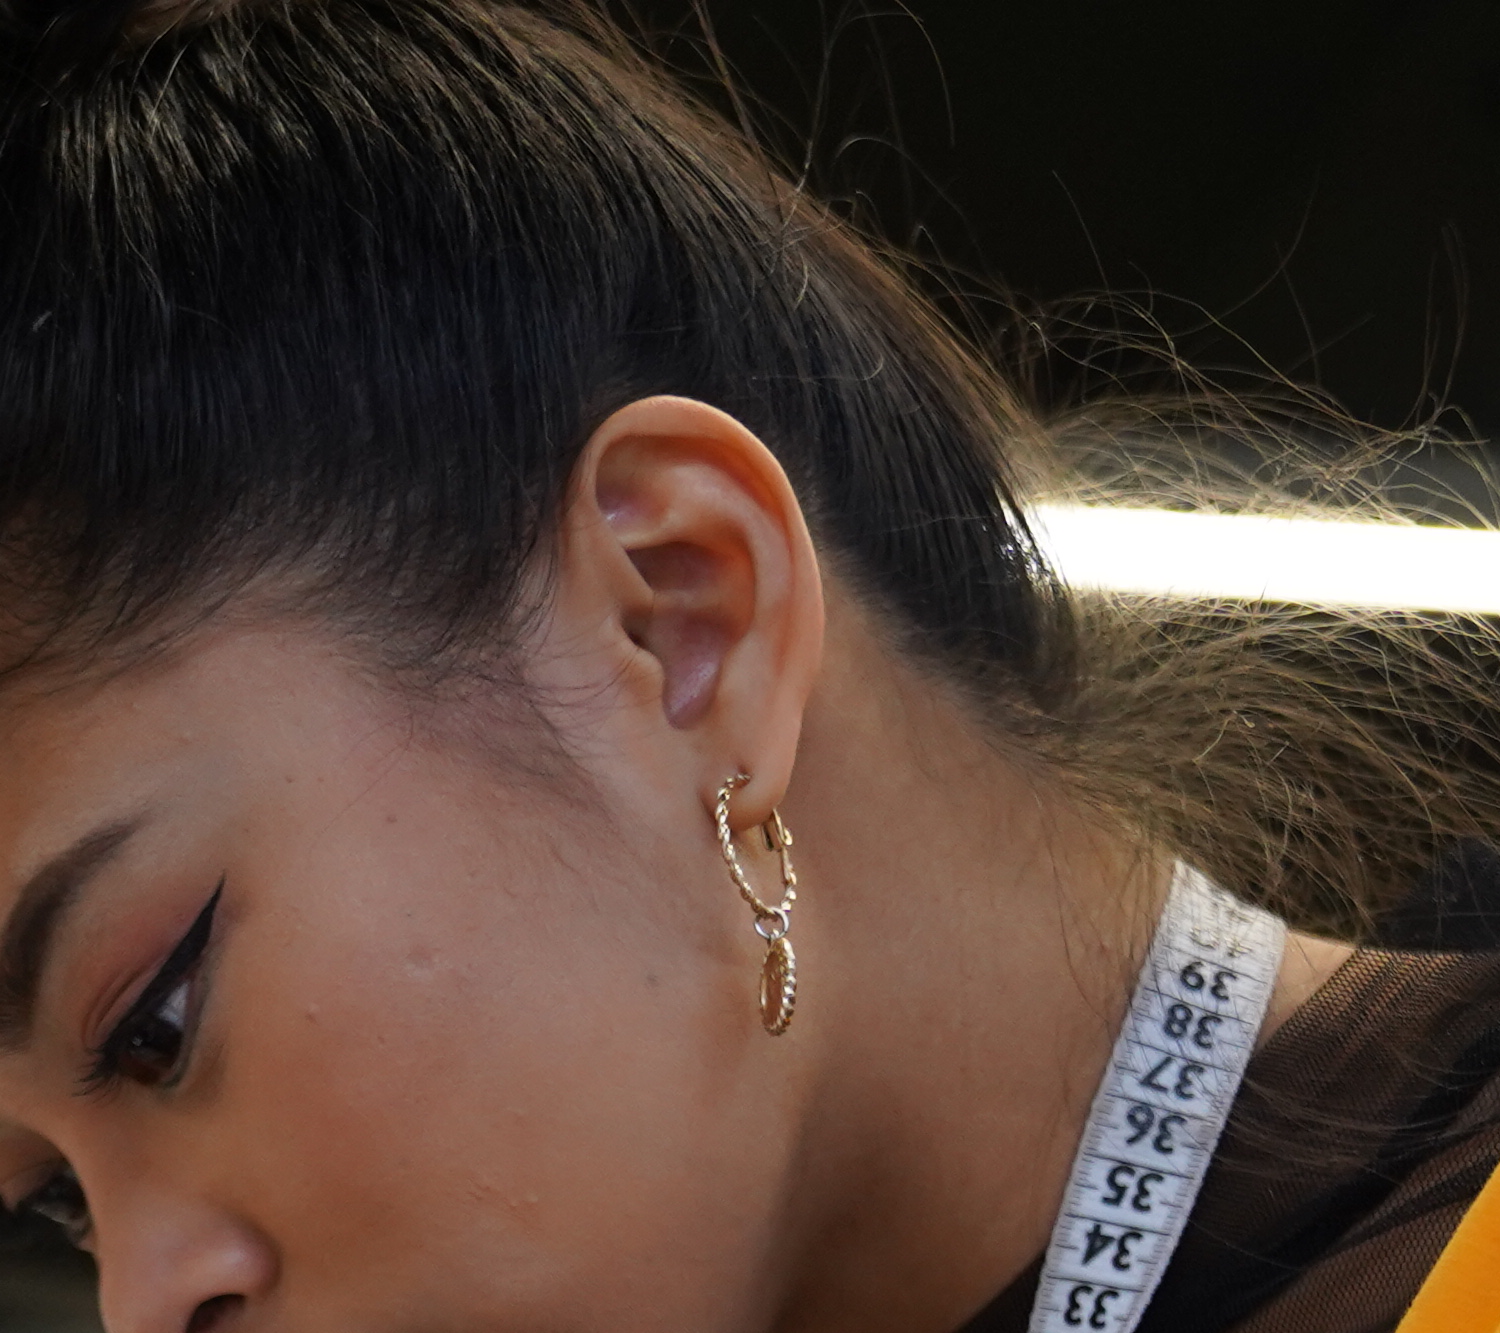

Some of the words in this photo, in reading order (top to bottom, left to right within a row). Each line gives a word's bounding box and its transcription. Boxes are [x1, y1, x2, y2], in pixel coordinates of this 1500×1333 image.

[1179, 961, 1239, 1001] 39
[1163, 1004, 1224, 1050] 38
[1139, 1056, 1205, 1100] 37
[1125, 1104, 1188, 1154] 36
[1101, 1165, 1164, 1212] 35
[1081, 1223, 1144, 1271] 34
[1063, 1285, 1120, 1330] 33
